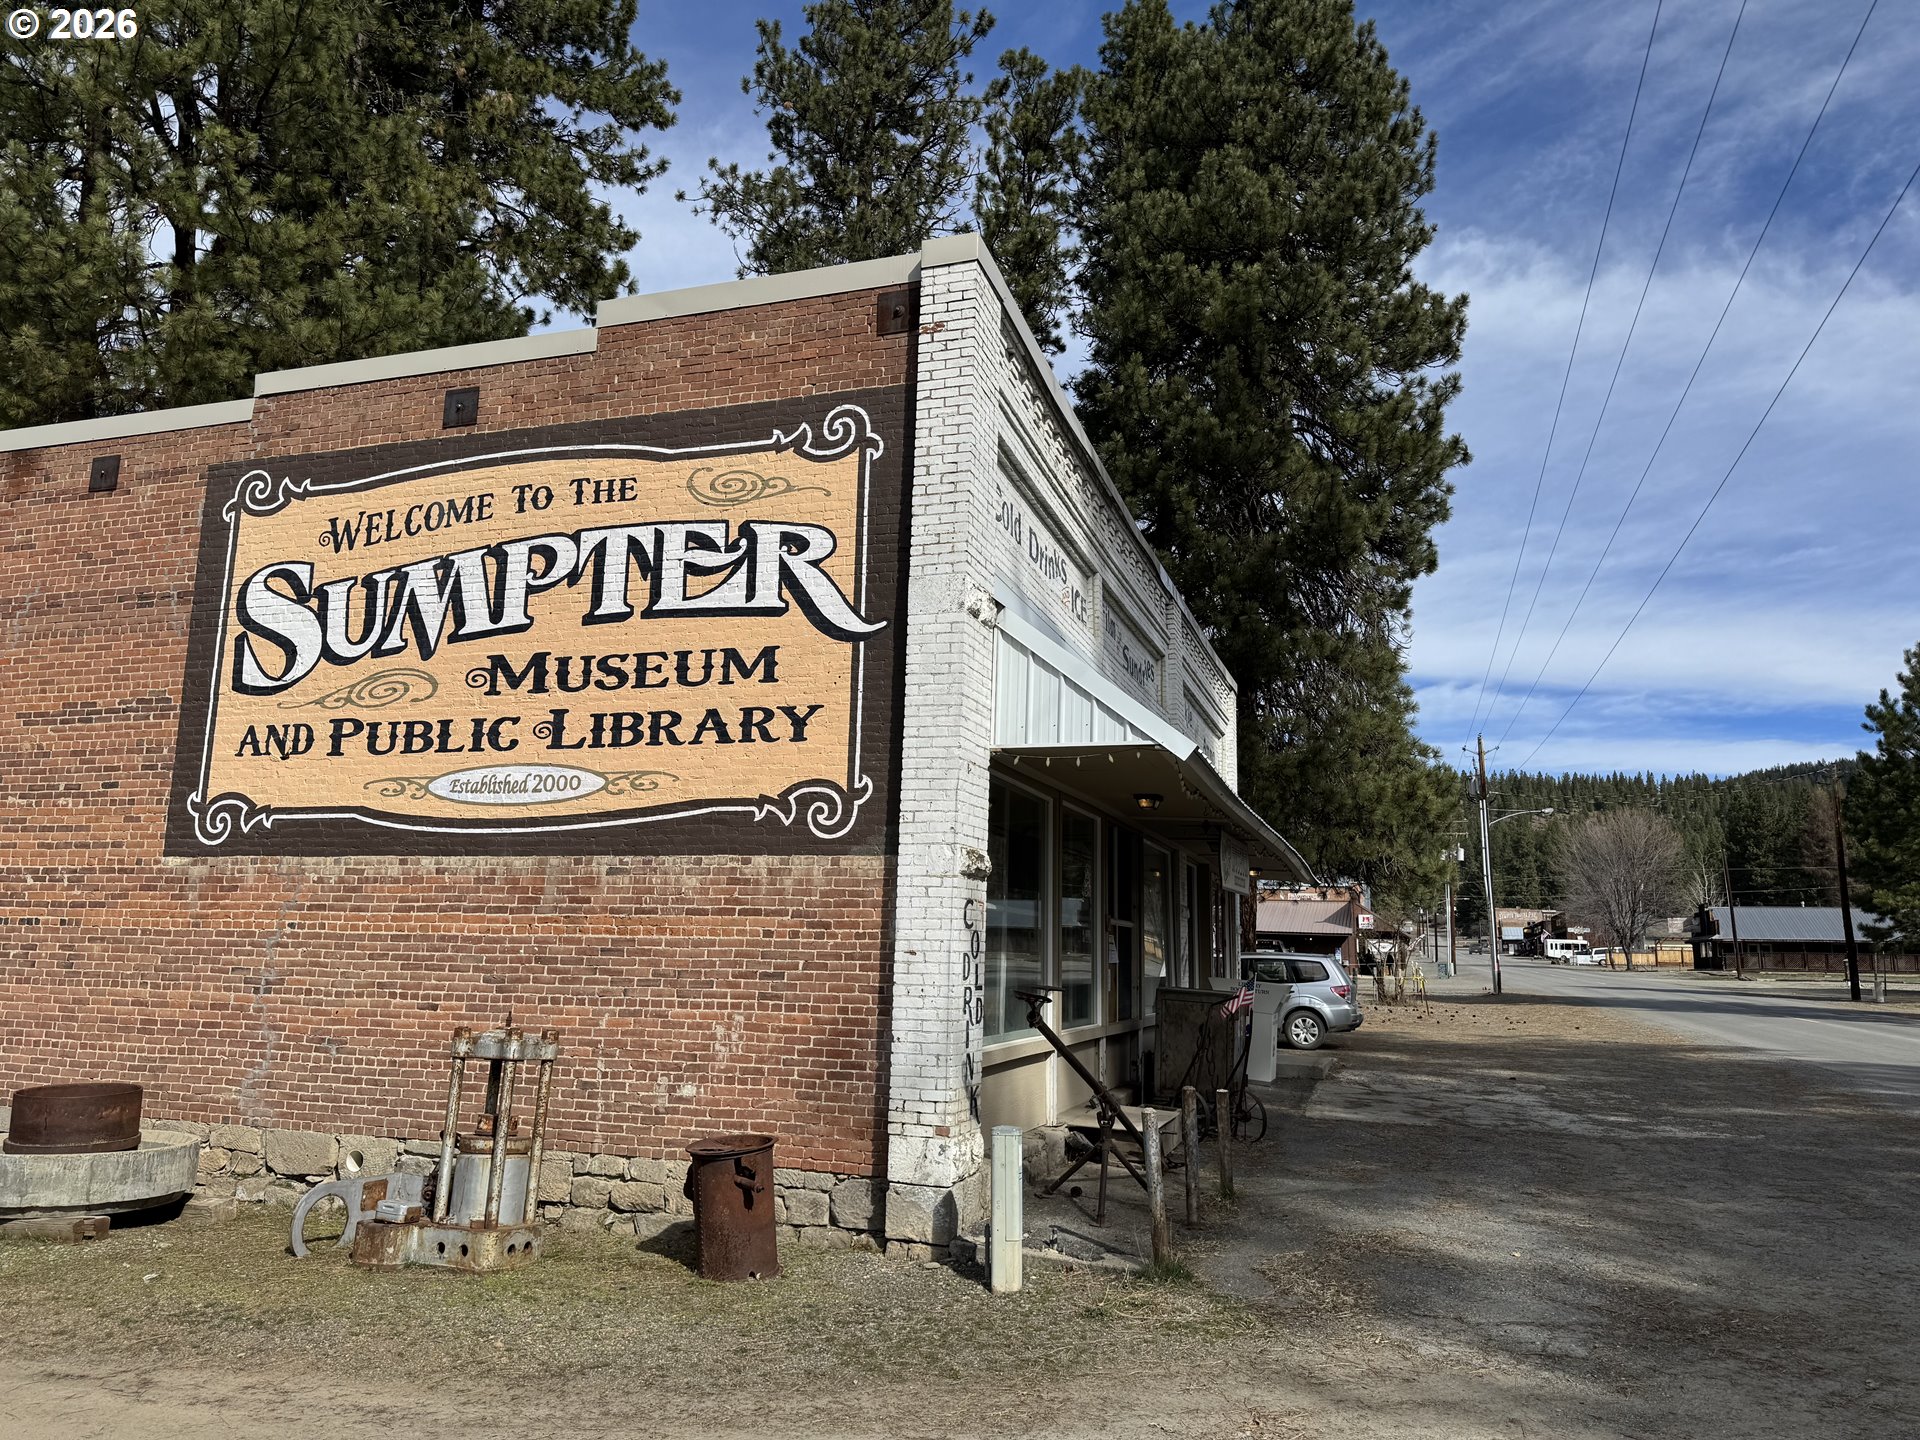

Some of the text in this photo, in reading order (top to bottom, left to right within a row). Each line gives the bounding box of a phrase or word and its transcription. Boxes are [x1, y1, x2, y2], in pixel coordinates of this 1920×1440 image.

[319, 477, 638, 554] WELCOME TO THE
[995, 483, 1067, 585] old Drinks
[232, 520, 888, 696] SUMPTER
[466, 646, 780, 695] MUSEUM
[235, 704, 824, 760] AND PUBLIC LIBRARY
[449, 774, 582, 795] Established 2000
[963, 900, 983, 1025] COLD
[962, 952, 981, 1125] DRINK
